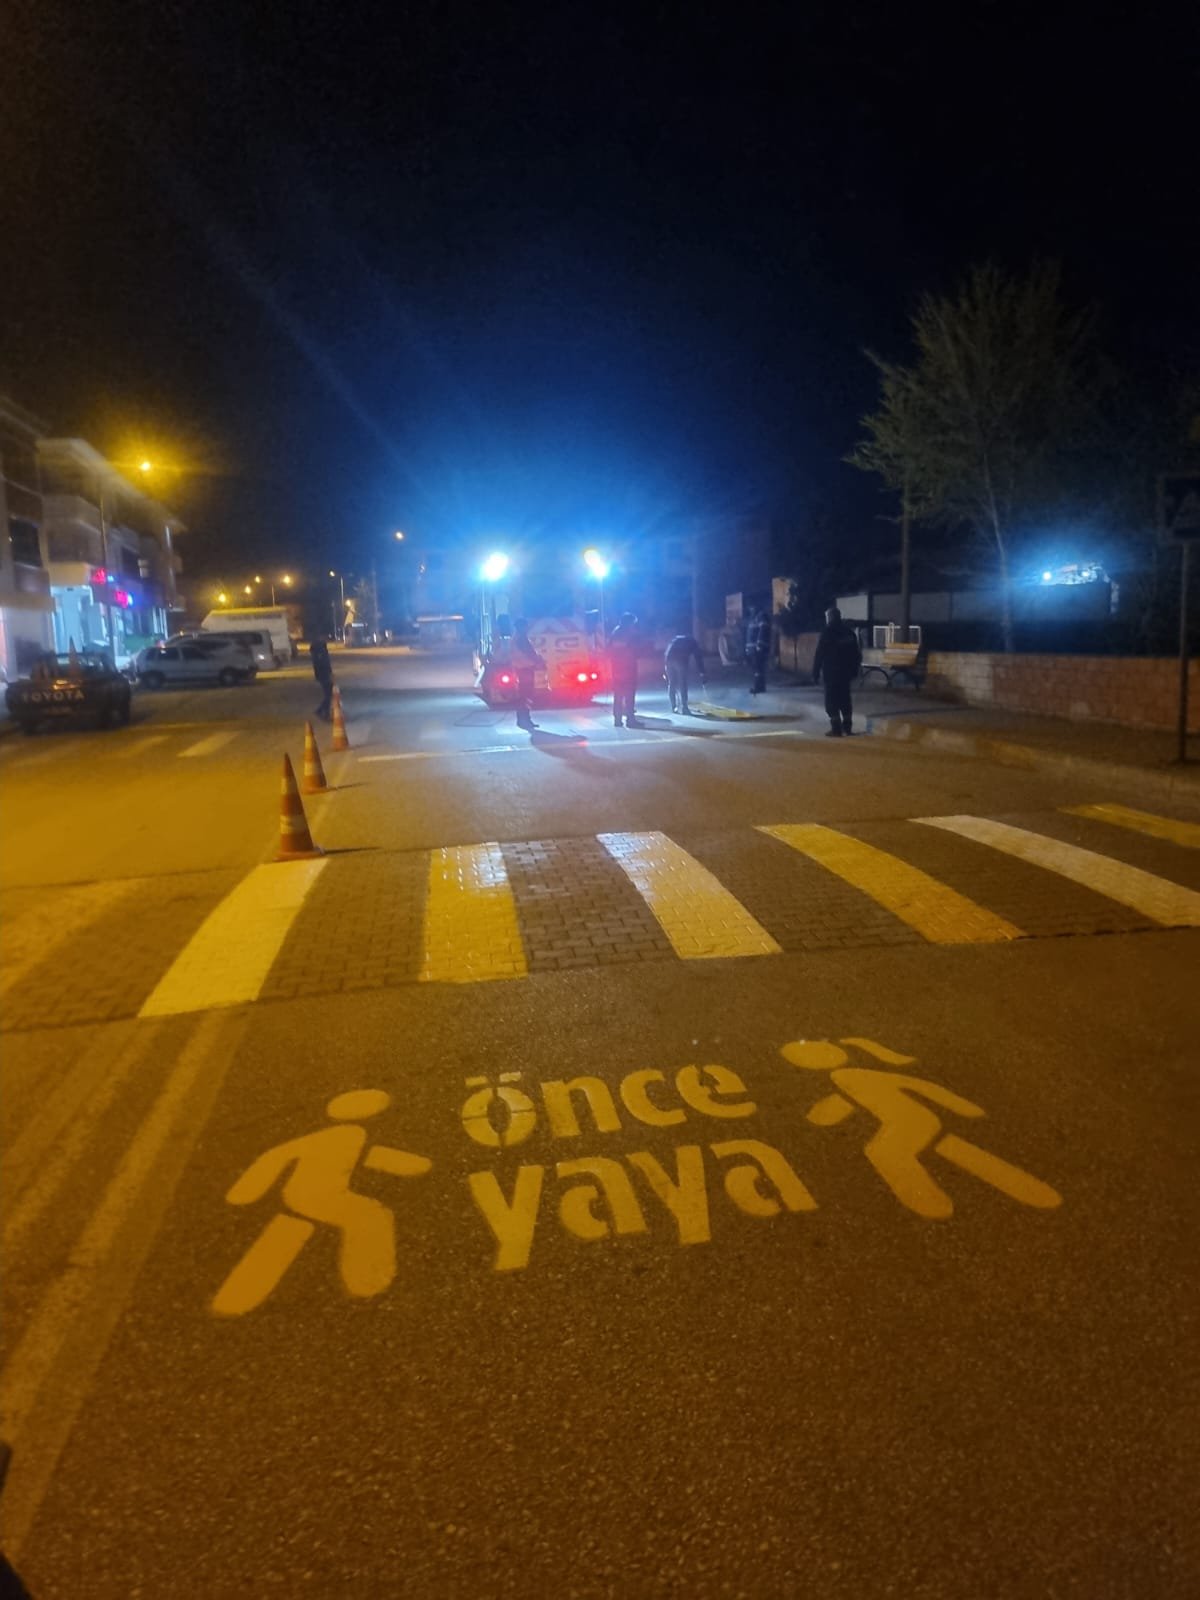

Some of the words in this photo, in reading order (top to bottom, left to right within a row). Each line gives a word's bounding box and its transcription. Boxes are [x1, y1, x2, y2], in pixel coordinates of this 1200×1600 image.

[22, 688, 85, 704] TOYOTA
[461, 1064, 757, 1147] önce
[468, 1139, 819, 1271] yaya
